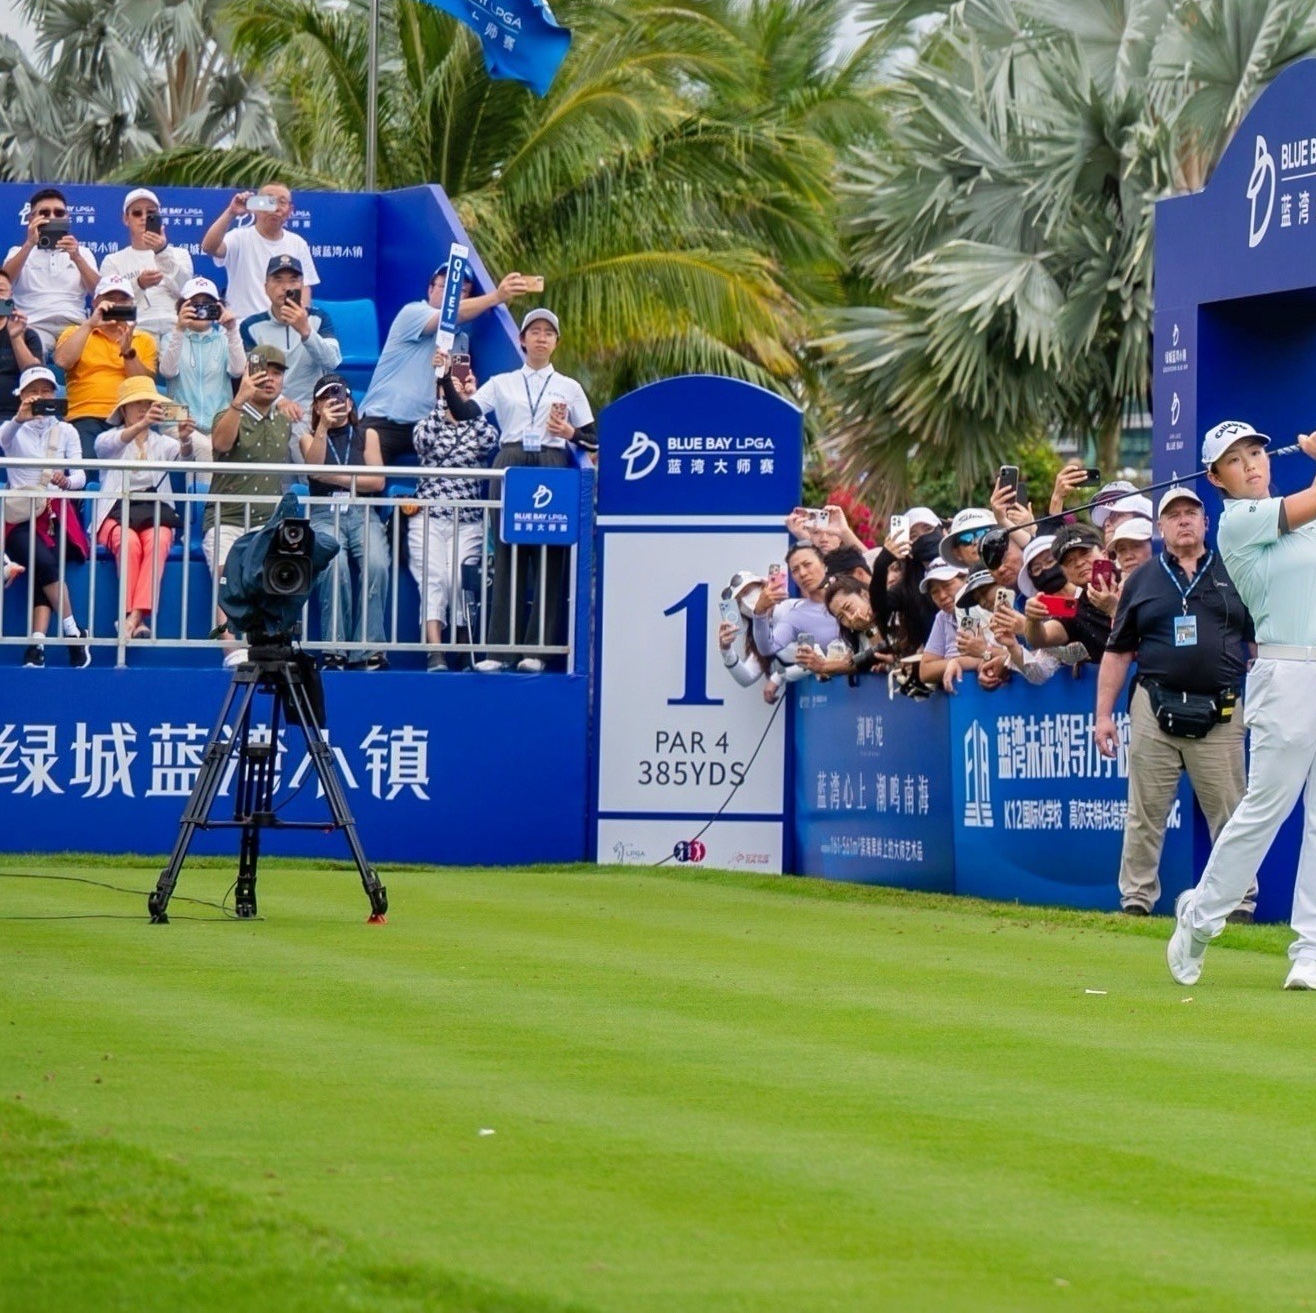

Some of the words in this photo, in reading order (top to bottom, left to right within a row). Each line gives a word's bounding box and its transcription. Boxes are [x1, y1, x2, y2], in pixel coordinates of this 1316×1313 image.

[490, 0, 523, 30] LPGA
[1281, 139, 1309, 170] BLUE
[162, 217, 204, 226] 湾大师赛
[169, 207, 183, 215] BAY
[309, 245, 363, 259] 城蓝湾小镇
[446, 258, 463, 320] QUIET
[1215, 423, 1247, 439] Callaway
[667, 437, 702, 450] BLUE
[705, 437, 733, 450] BAY
[736, 437, 775, 450] LPGA
[667, 458, 774, 474] 蓝湾大师赛
[514, 512, 532, 521] BLUE
[533, 513, 547, 521] BAY
[663, 583, 724, 706] 1
[655, 731, 707, 754] PAR
[715, 731, 729, 754] 4
[638, 760, 746, 787] 385YDS
[817, 770, 867, 810] 蓝湾心上
[876, 772, 929, 815] 潮鸣南海
[1004, 799, 1063, 830] K12国际化学校
